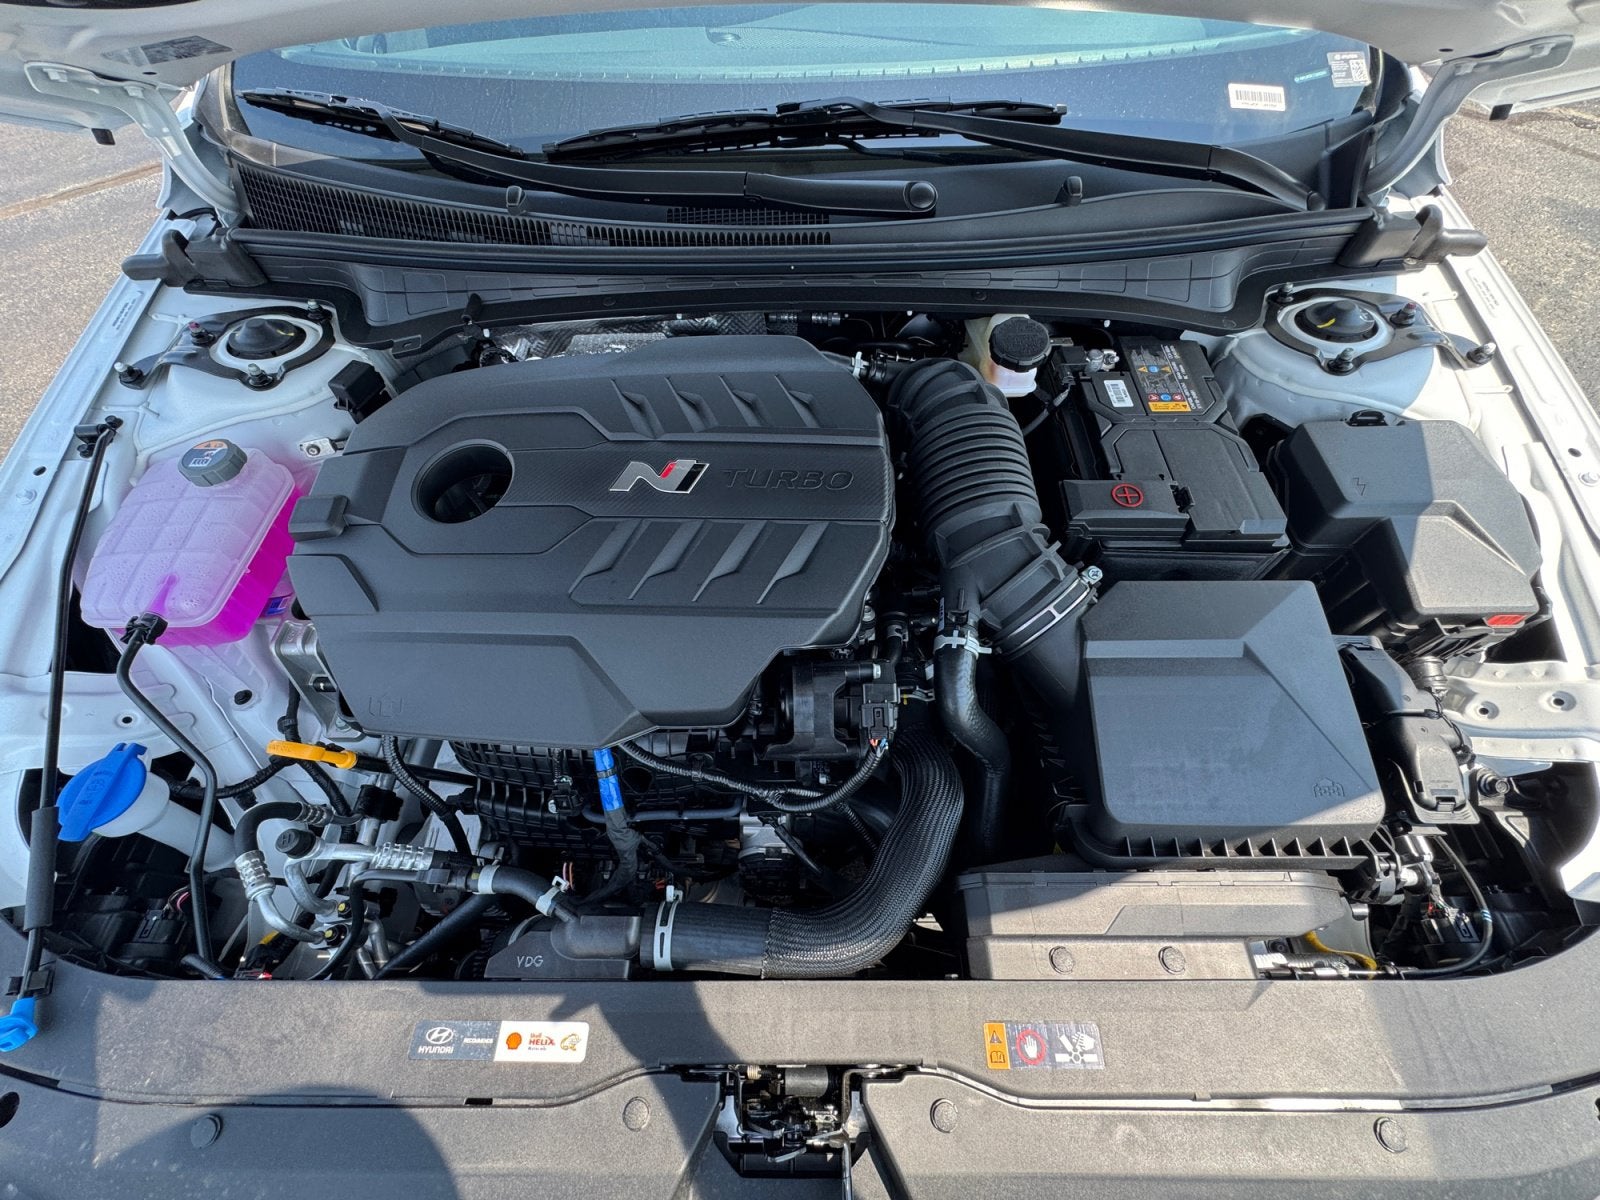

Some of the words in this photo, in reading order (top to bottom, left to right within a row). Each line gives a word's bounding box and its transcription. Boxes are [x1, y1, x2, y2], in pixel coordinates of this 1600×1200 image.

[721, 468, 855, 491] TURBO
[528, 1036, 556, 1046] HELIX
[418, 1045, 454, 1054] HYUNDAI
